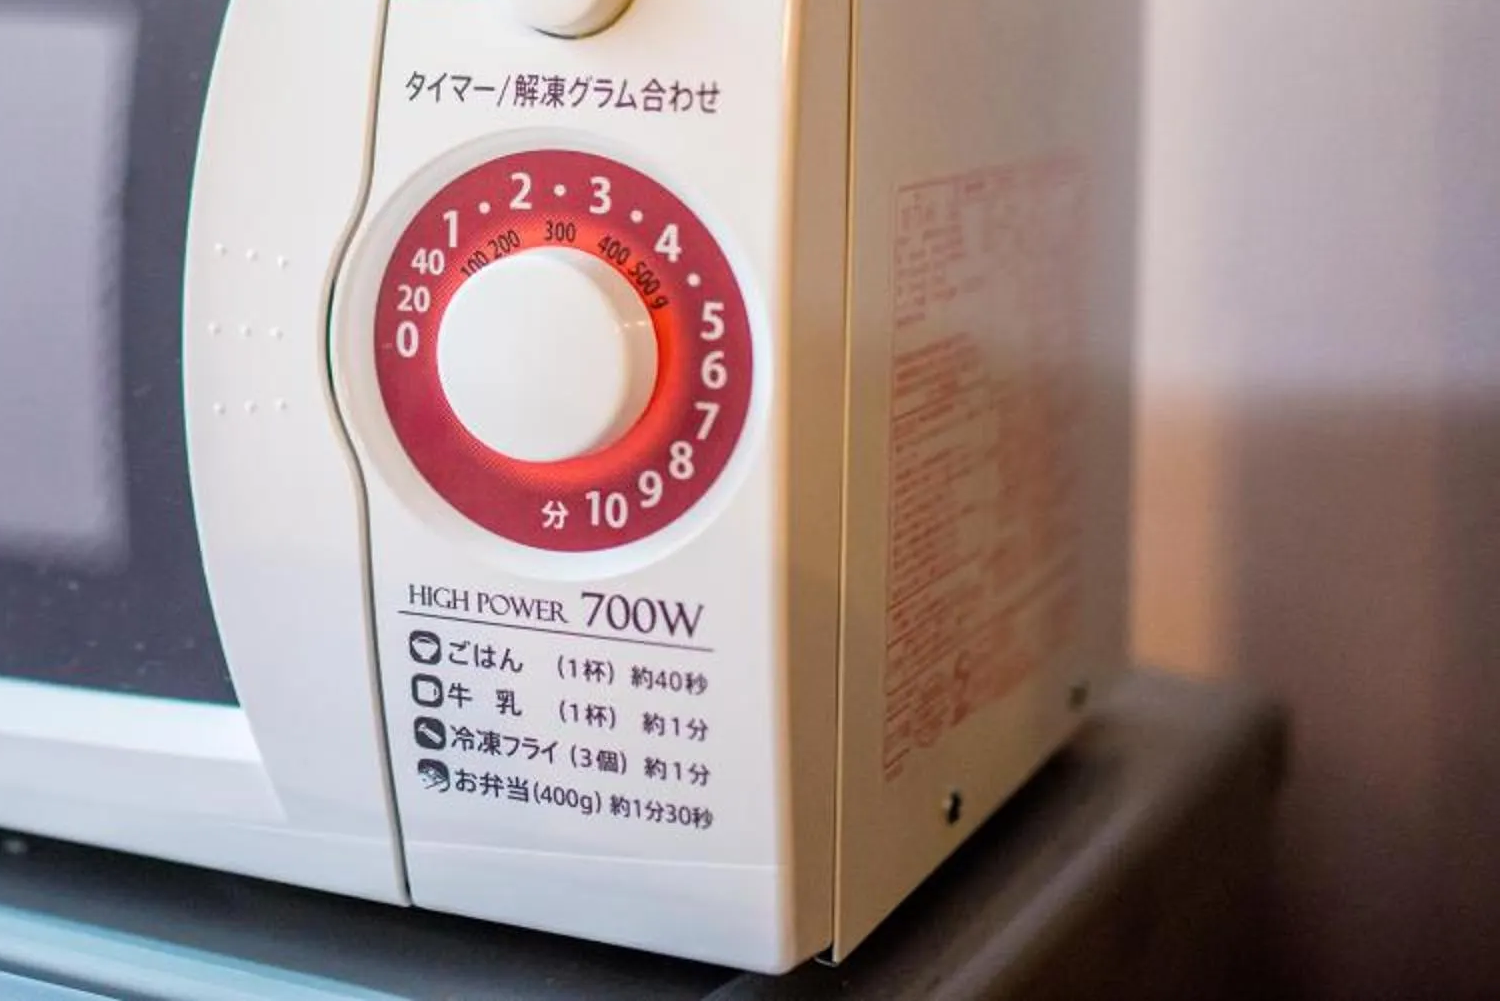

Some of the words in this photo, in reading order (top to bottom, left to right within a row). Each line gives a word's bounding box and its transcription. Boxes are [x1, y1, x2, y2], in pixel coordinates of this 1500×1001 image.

[509, 172, 533, 210] 2
[589, 176, 612, 215] 3
[443, 209, 459, 248] 1
[488, 229, 521, 258] 200
[544, 220, 576, 243] 300
[597, 235, 630, 265] 400
[654, 222, 682, 262] 4
[411, 247, 445, 276] 40
[397, 285, 430, 312] 20
[396, 320, 419, 358] 0
[701, 301, 725, 340] 5
[702, 350, 728, 389] 6
[695, 402, 720, 440] 7
[669, 441, 695, 480] 8
[639, 470, 664, 508] 9
[541, 501, 569, 531] 分
[586, 491, 629, 529] 10
[408, 584, 470, 611] HIGH
[477, 592, 569, 624] POWER
[581, 591, 705, 639] 700W
[448, 640, 523, 673] ごはん
[450, 725, 559, 764] 冷凍フライ
